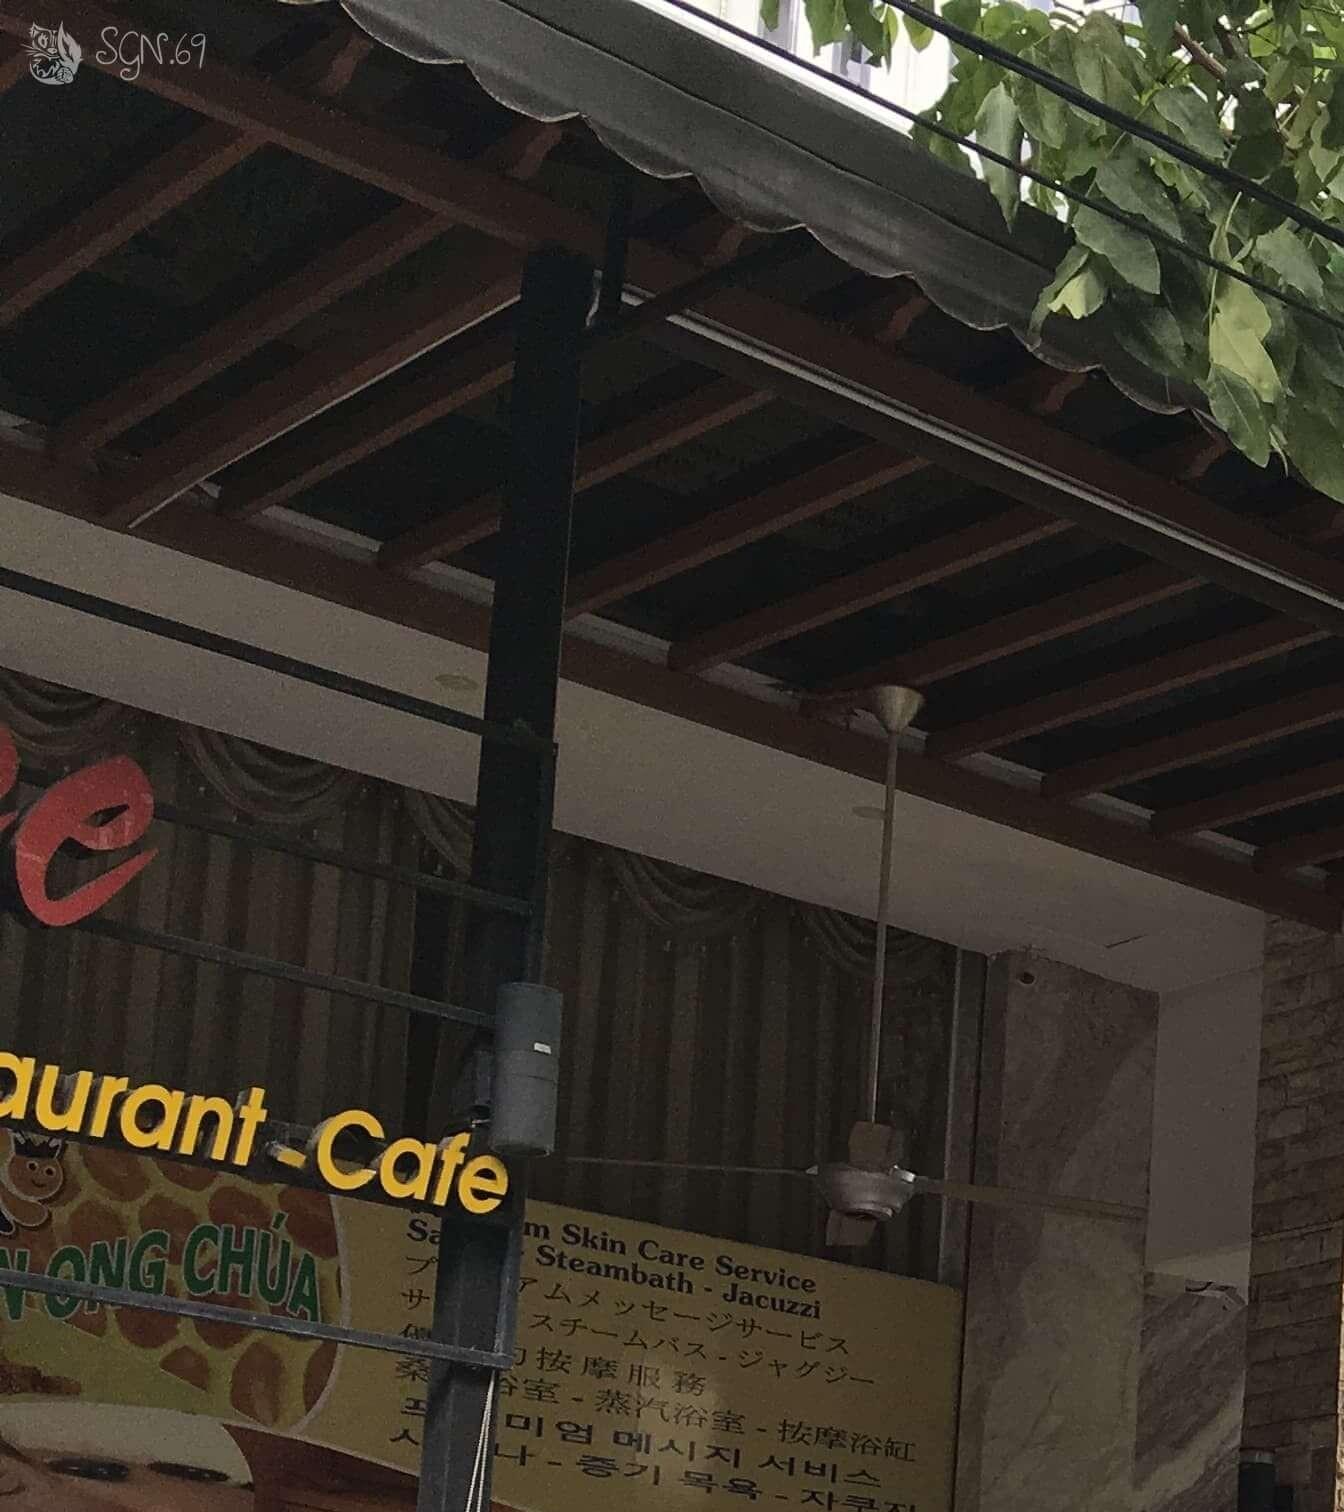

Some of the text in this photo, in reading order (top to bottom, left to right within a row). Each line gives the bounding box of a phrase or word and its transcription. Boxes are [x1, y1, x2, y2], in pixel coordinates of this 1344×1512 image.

[317, 1109, 509, 1214] Cafe
[183, 1212, 323, 1324] CHÚA
[536, 1245, 693, 1294] Steambath
[723, 1282, 821, 1319] Jacuzzi
[562, 1223, 626, 1255] Skin
[638, 1239, 705, 1270] Care
[716, 1255, 816, 1293] Service
